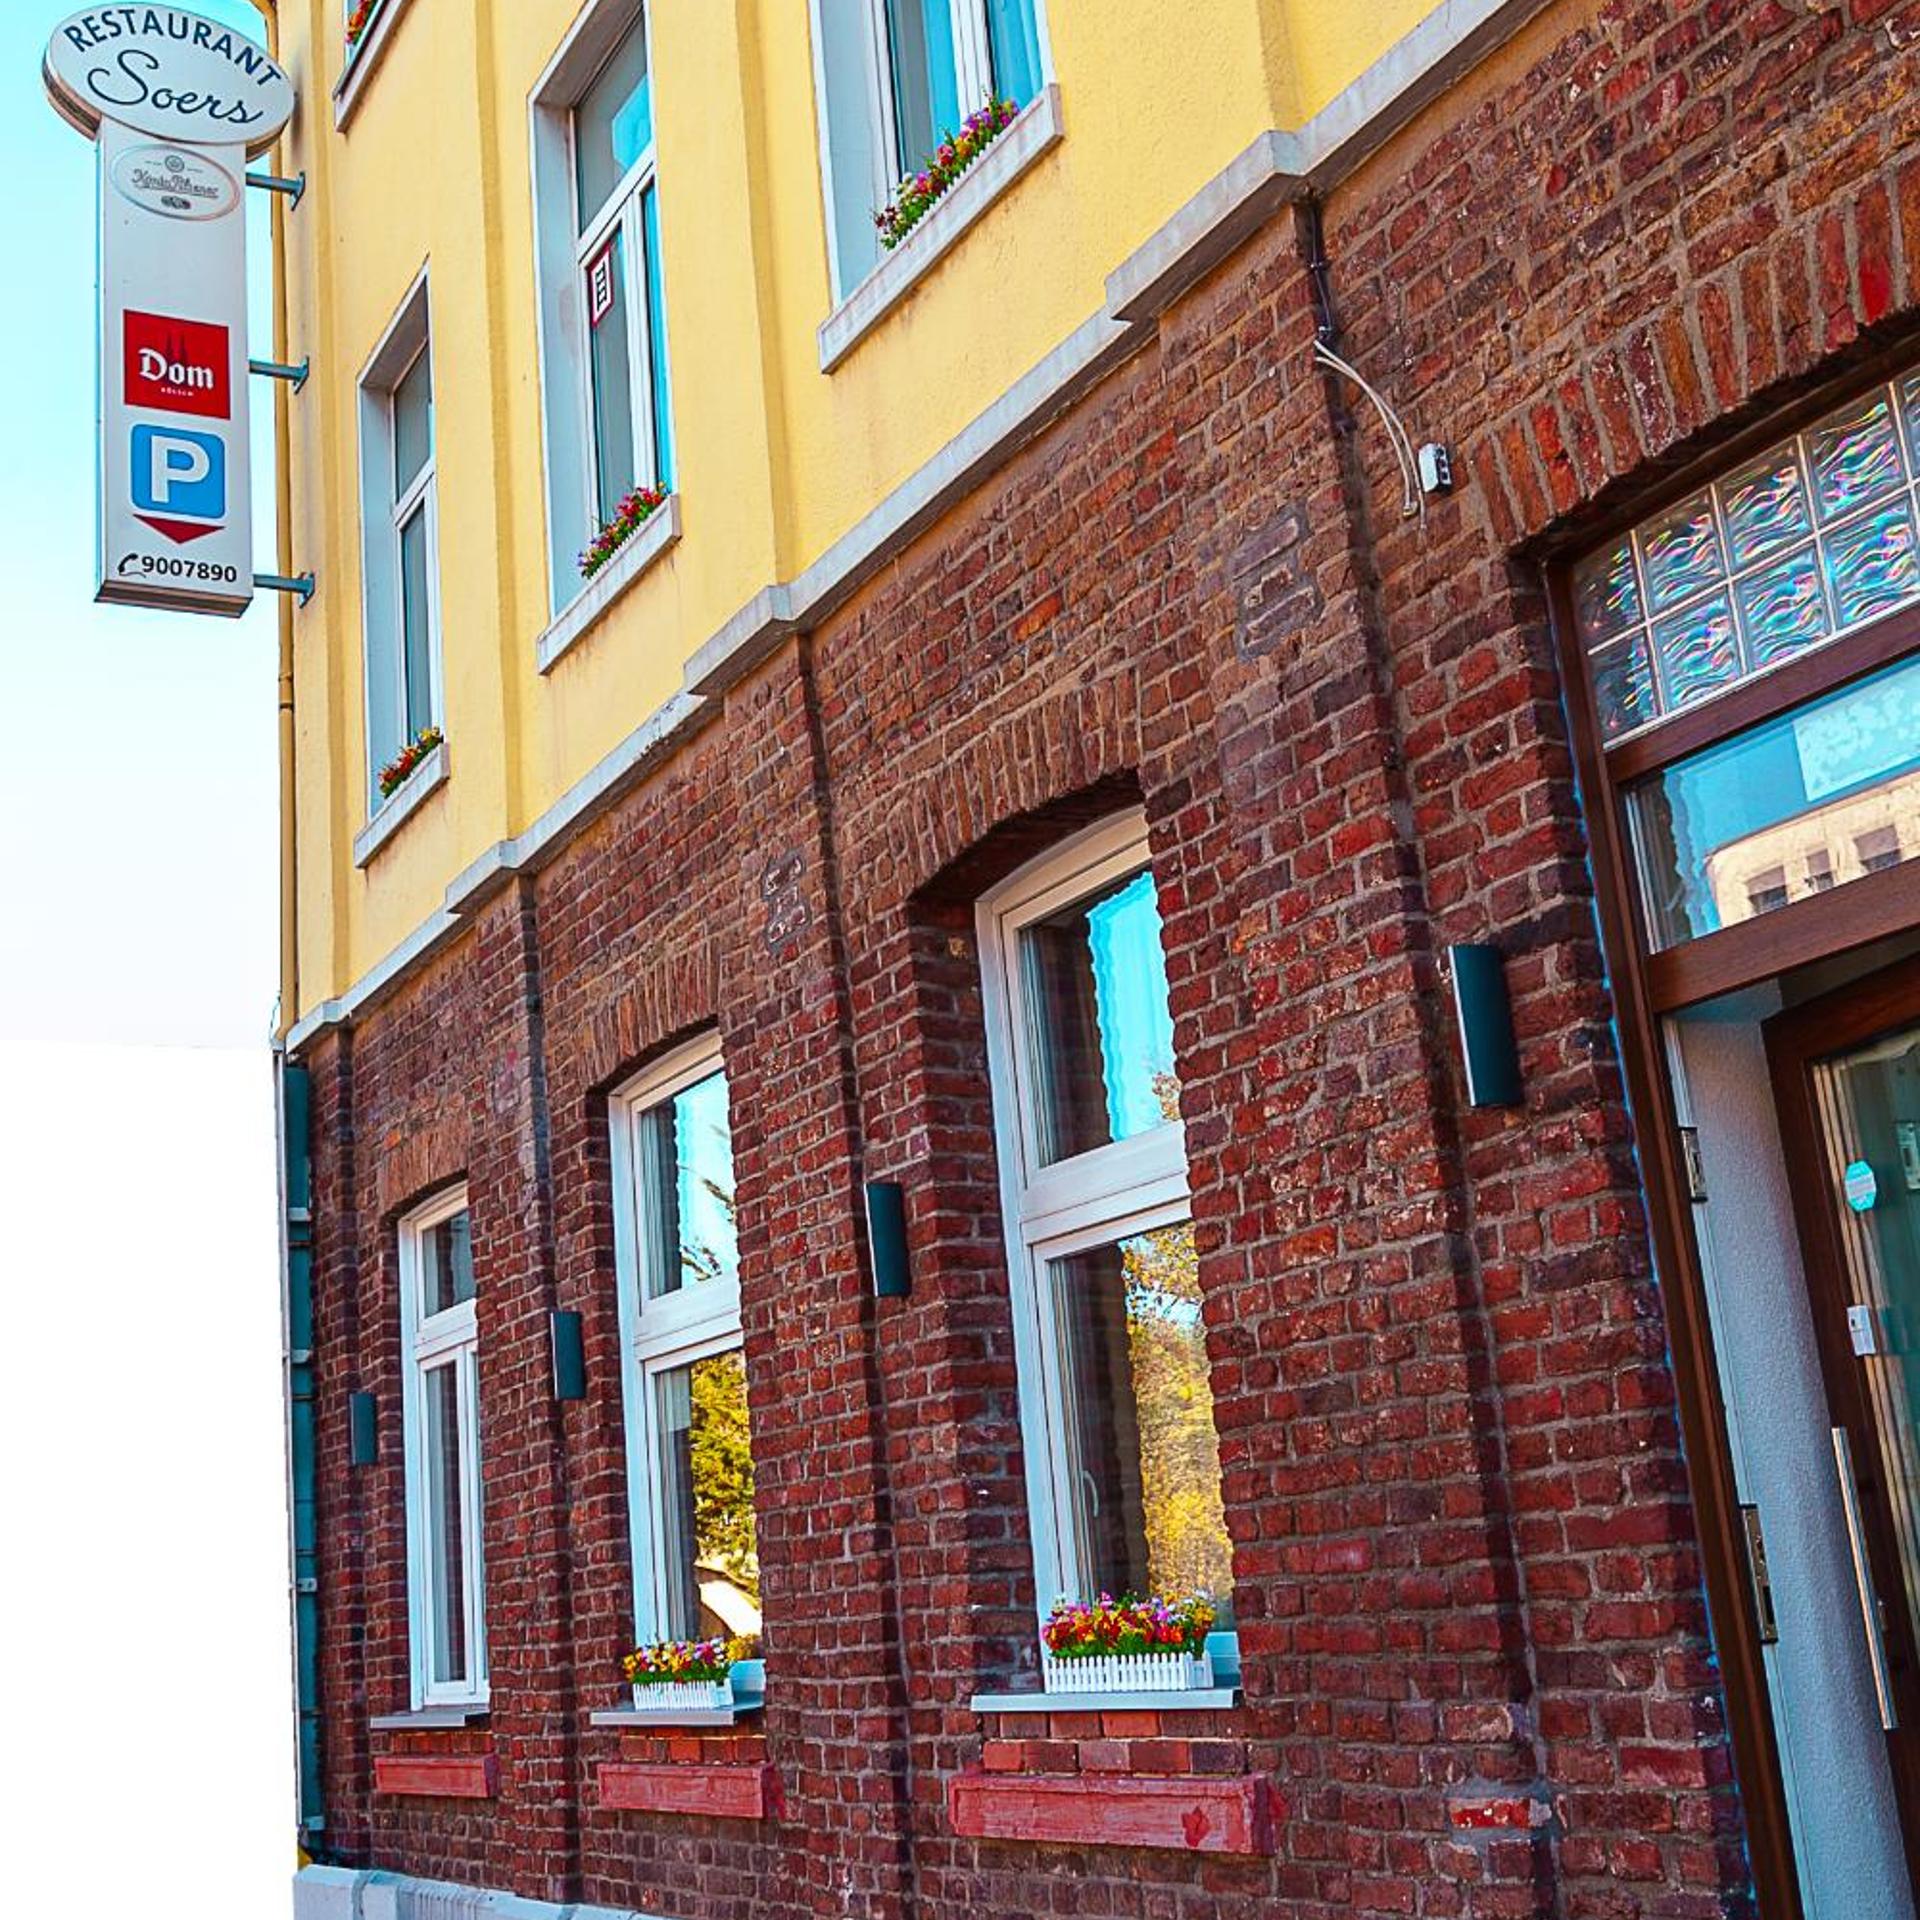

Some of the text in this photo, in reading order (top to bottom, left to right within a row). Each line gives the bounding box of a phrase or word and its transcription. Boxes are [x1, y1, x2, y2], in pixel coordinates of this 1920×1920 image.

[63, 8, 282, 86] RESTAURANT
[86, 49, 264, 124] Soers
[138, 347, 213, 391] Dom
[150, 434, 211, 504] P
[141, 555, 238, 583] 9007890
